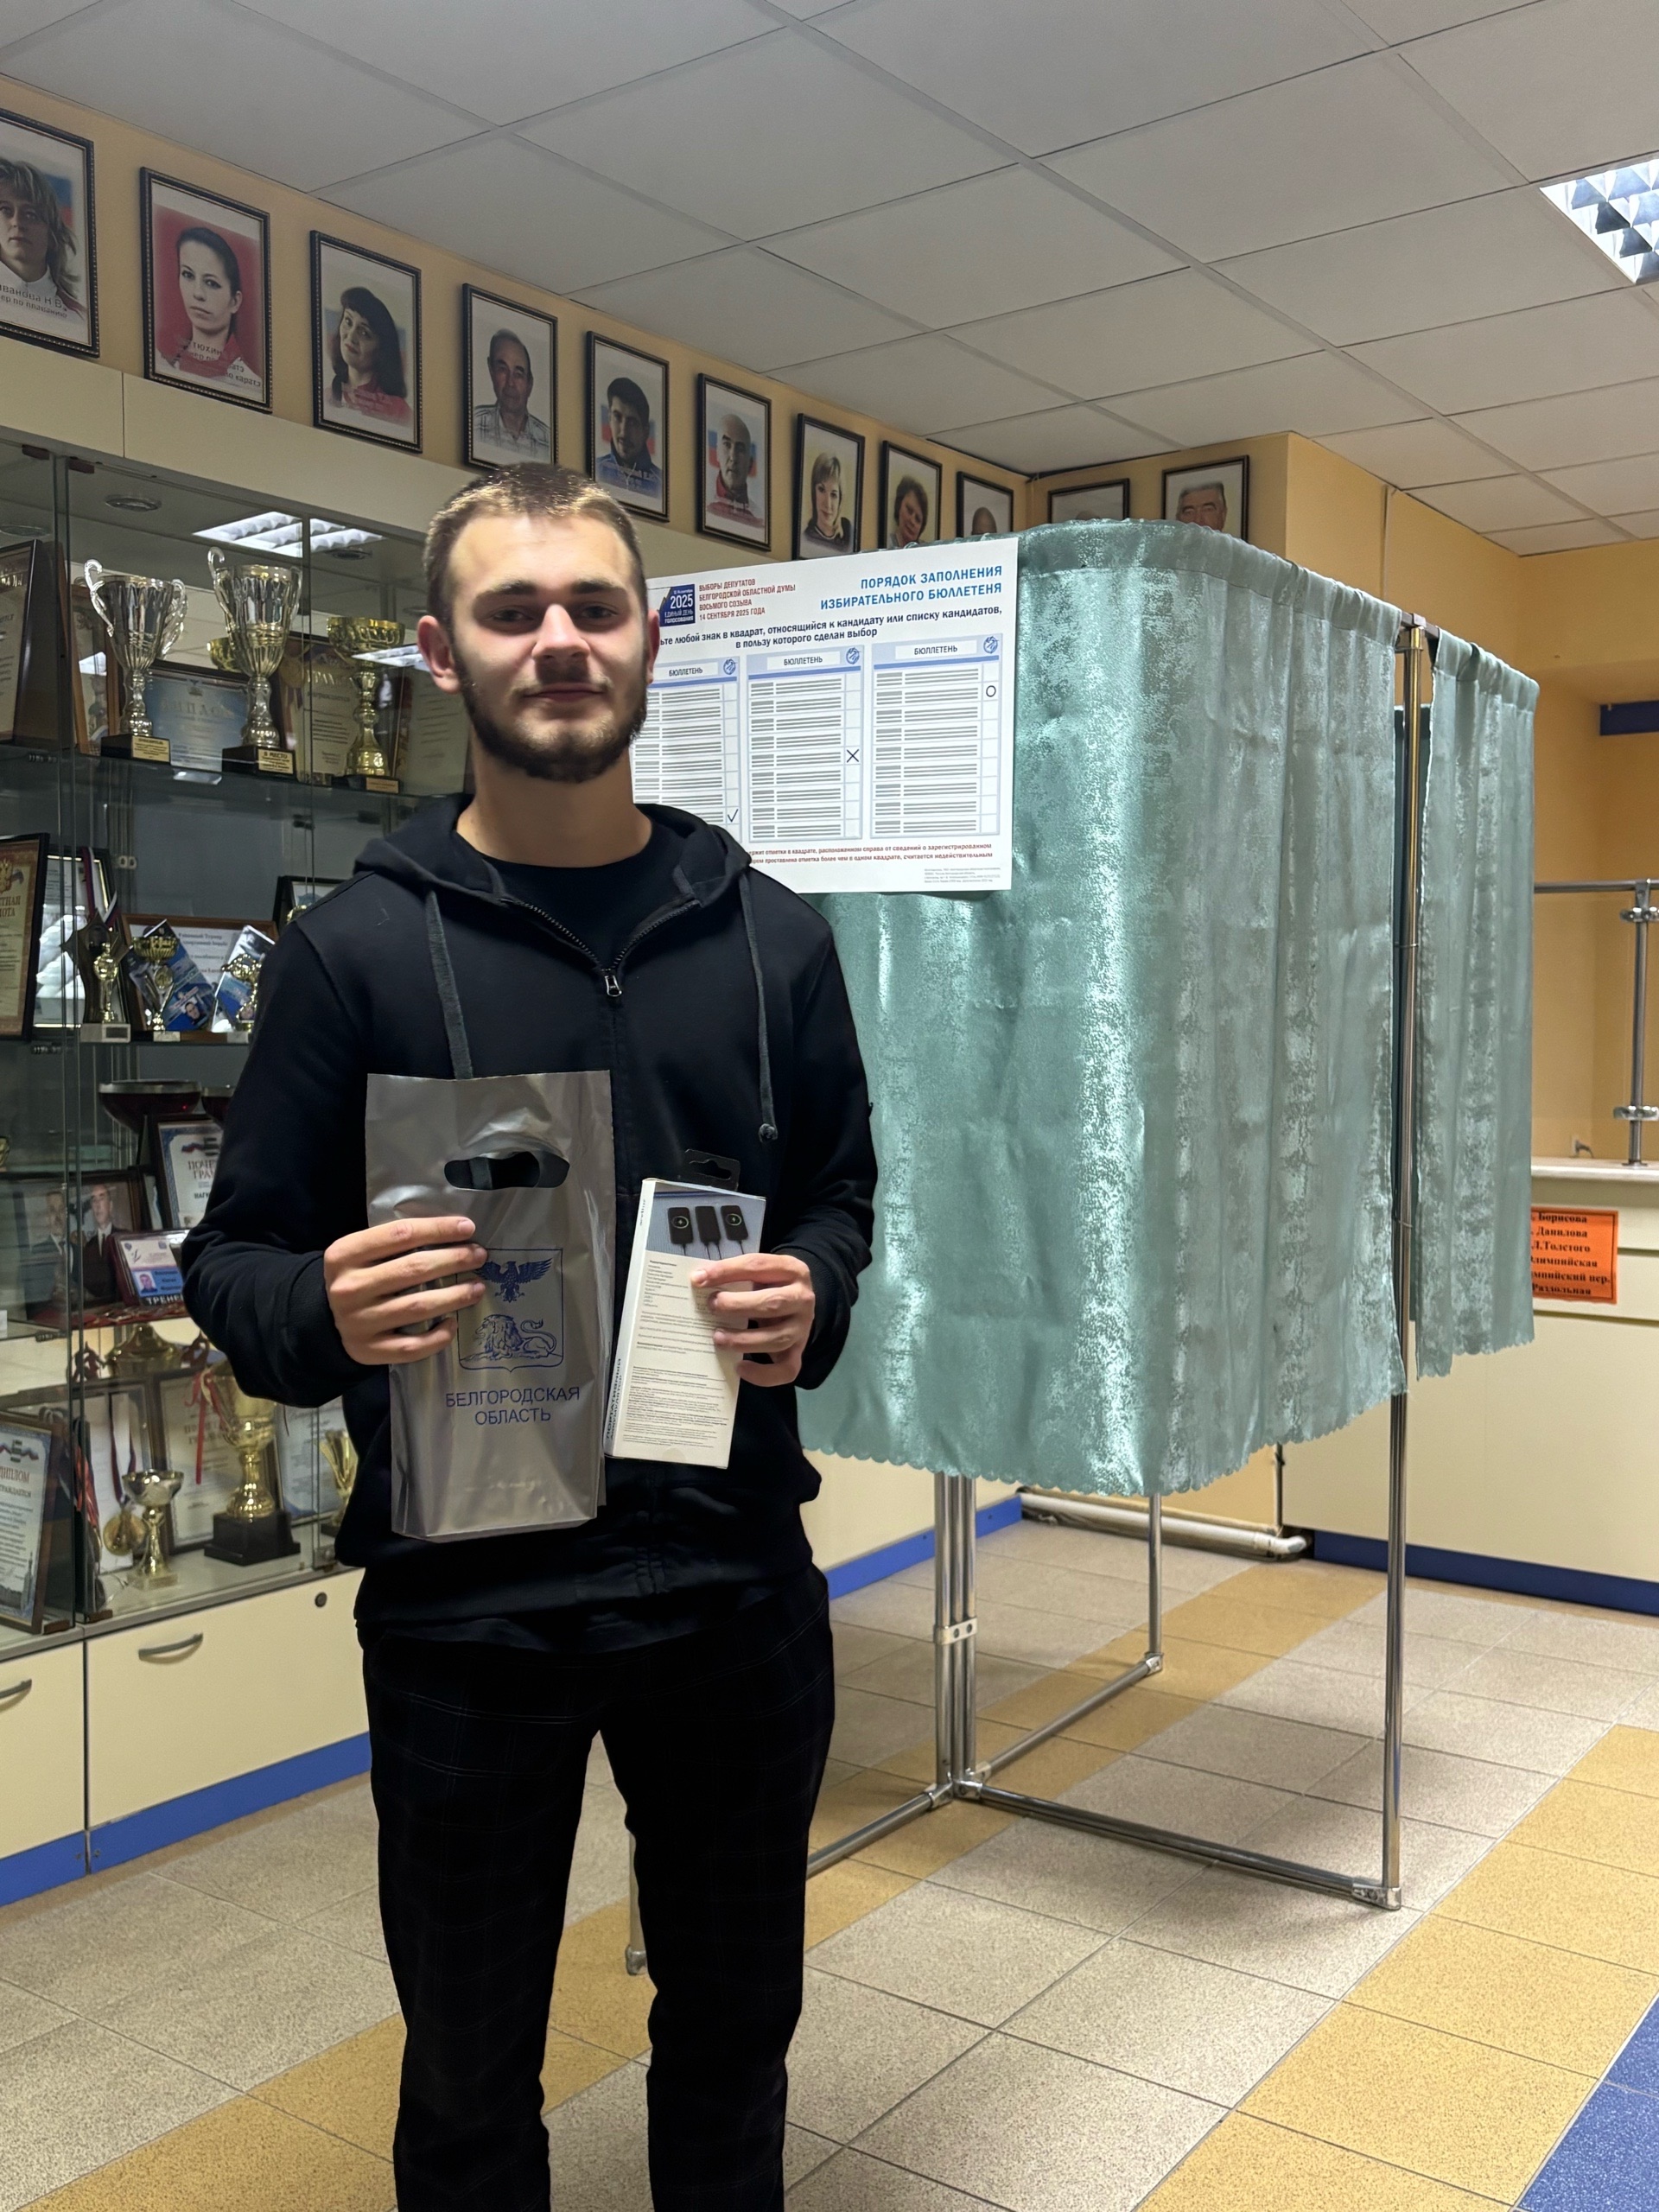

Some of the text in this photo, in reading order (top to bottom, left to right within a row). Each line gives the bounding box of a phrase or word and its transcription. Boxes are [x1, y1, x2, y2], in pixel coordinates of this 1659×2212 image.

[861, 565, 1002, 589] ПОРЯДОК ЗАПОЛНЕНИЯ
[699, 578, 756, 591] ВЫБОРЫ ДЕПУТАТОВ
[699, 589, 741, 601] БЕЛГОРОДСКОЙ
[742, 585, 776, 596] ОБЛАСТНОЙ
[776, 584, 796, 594] ДУМЫ
[821, 582, 1002, 610] ИЗБИРАТЕЛЬНОГО БЮЛЛЕТЕНЯ
[670, 594, 694, 609] 2025
[699, 599, 753, 611] ВОСЬМОГО СОЗЫВА
[707, 610, 735, 620] СЕНТЯБРЯ
[750, 607, 766, 615] ГОДА
[674, 632, 700, 645] любой
[702, 632, 721, 642] знак
[729, 627, 766, 639] квадрат,
[767, 621, 827, 635] относящийся
[837, 614, 884, 628] кандидату
[887, 614, 904, 624] или
[906, 611, 940, 622] списку
[942, 606, 1002, 620] кандидатов,
[743, 639, 771, 649] пользу
[772, 634, 812, 645] которого
[814, 631, 845, 642] сделан
[847, 627, 878, 639] выбор
[913, 645, 958, 656] БЮЛЛЕТЕНЬ
[784, 656, 823, 666] БЮЛЛЕТЕНЬ
[668, 666, 703, 677] БЮЛЛЕТЕНЬ
[0, 895, 21, 906] ТНАЯ
[1538, 1211, 1587, 1224] Борисова
[1536, 1226, 1587, 1237] Данилова
[1530, 1255, 1598, 1268] лимпийская
[1531, 1270, 1610, 1285] мпийский пер.
[445, 1386, 580, 1408] БЕЛГОРОДСКАЯ
[475, 1408, 551, 1425] ОБЛАСТЬ
